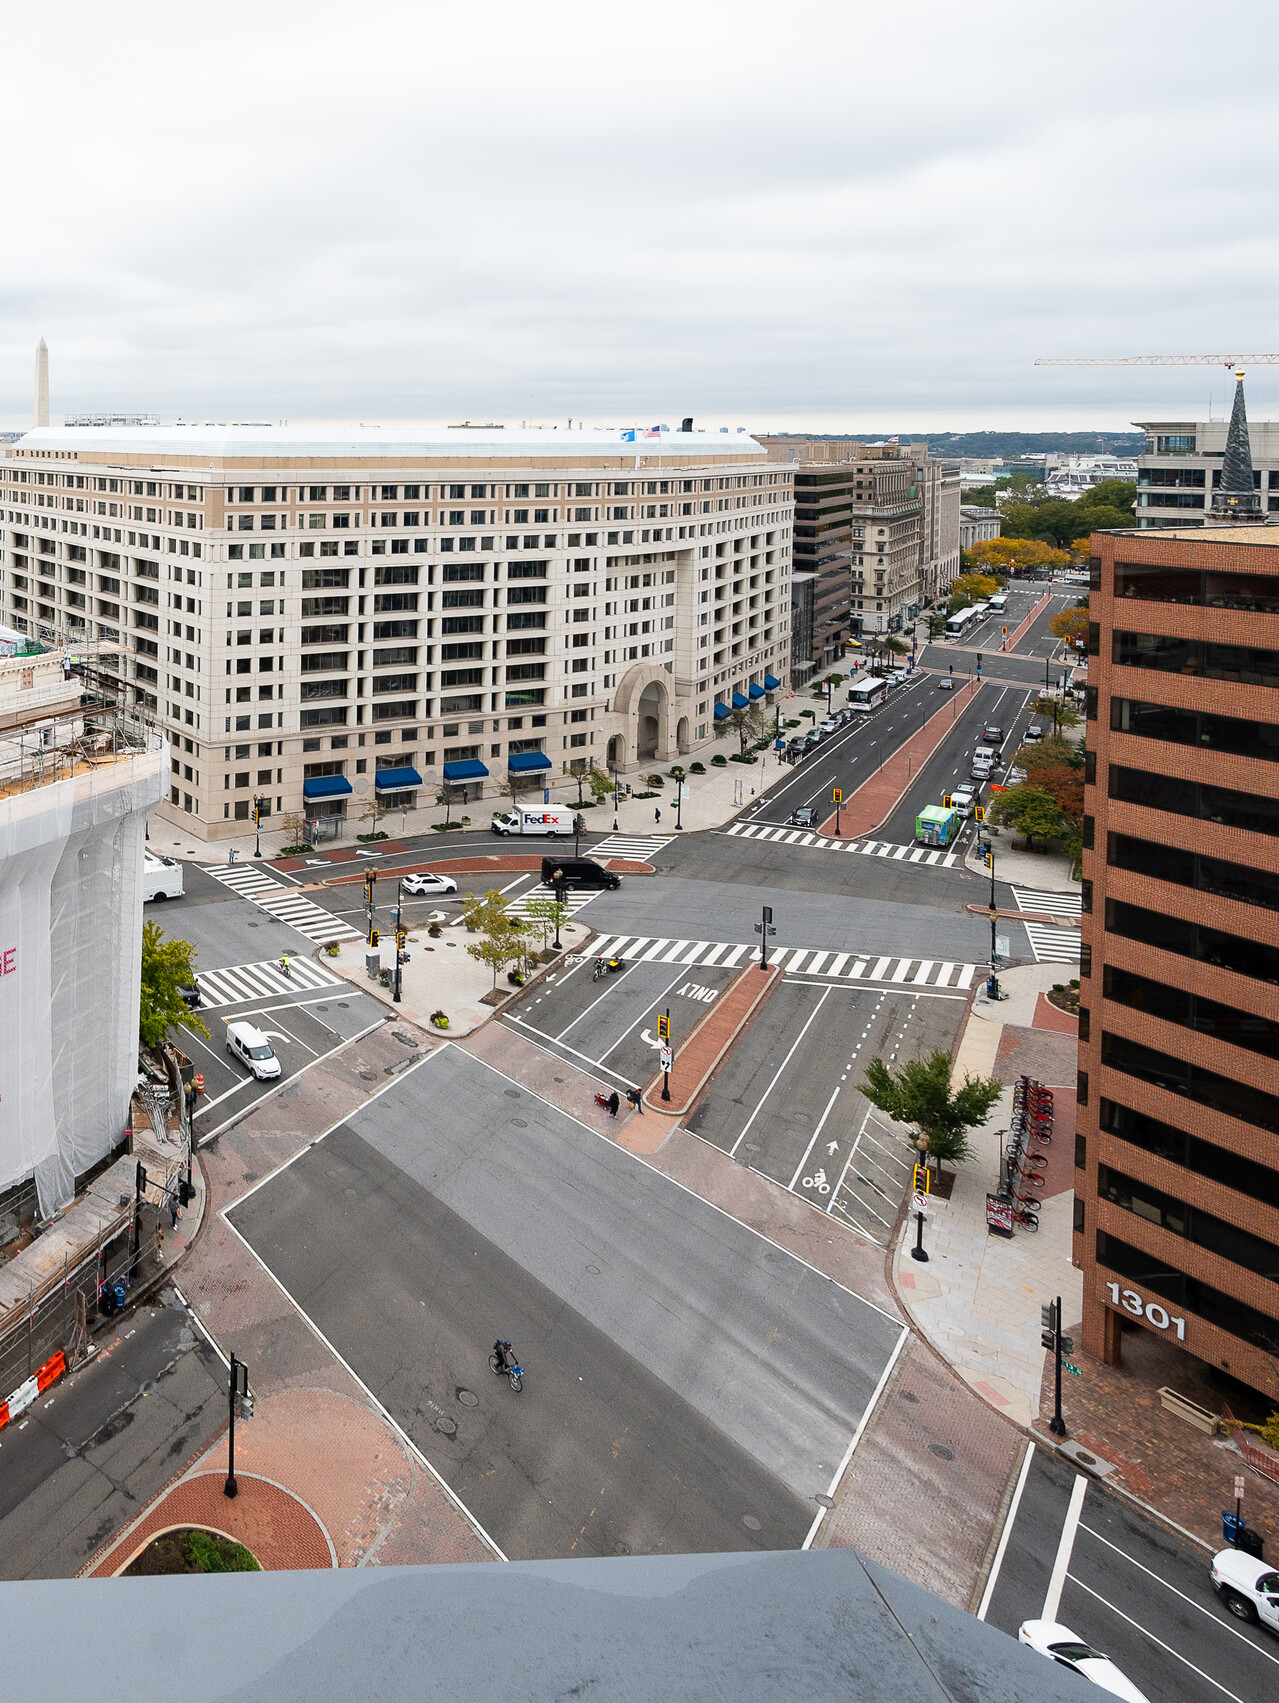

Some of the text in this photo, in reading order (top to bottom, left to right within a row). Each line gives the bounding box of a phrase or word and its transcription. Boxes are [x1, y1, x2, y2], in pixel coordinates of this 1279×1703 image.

[524, 813, 559, 824] FedEx
[676, 982, 719, 1003] ONLY
[1106, 1281, 1186, 1341] 1301
